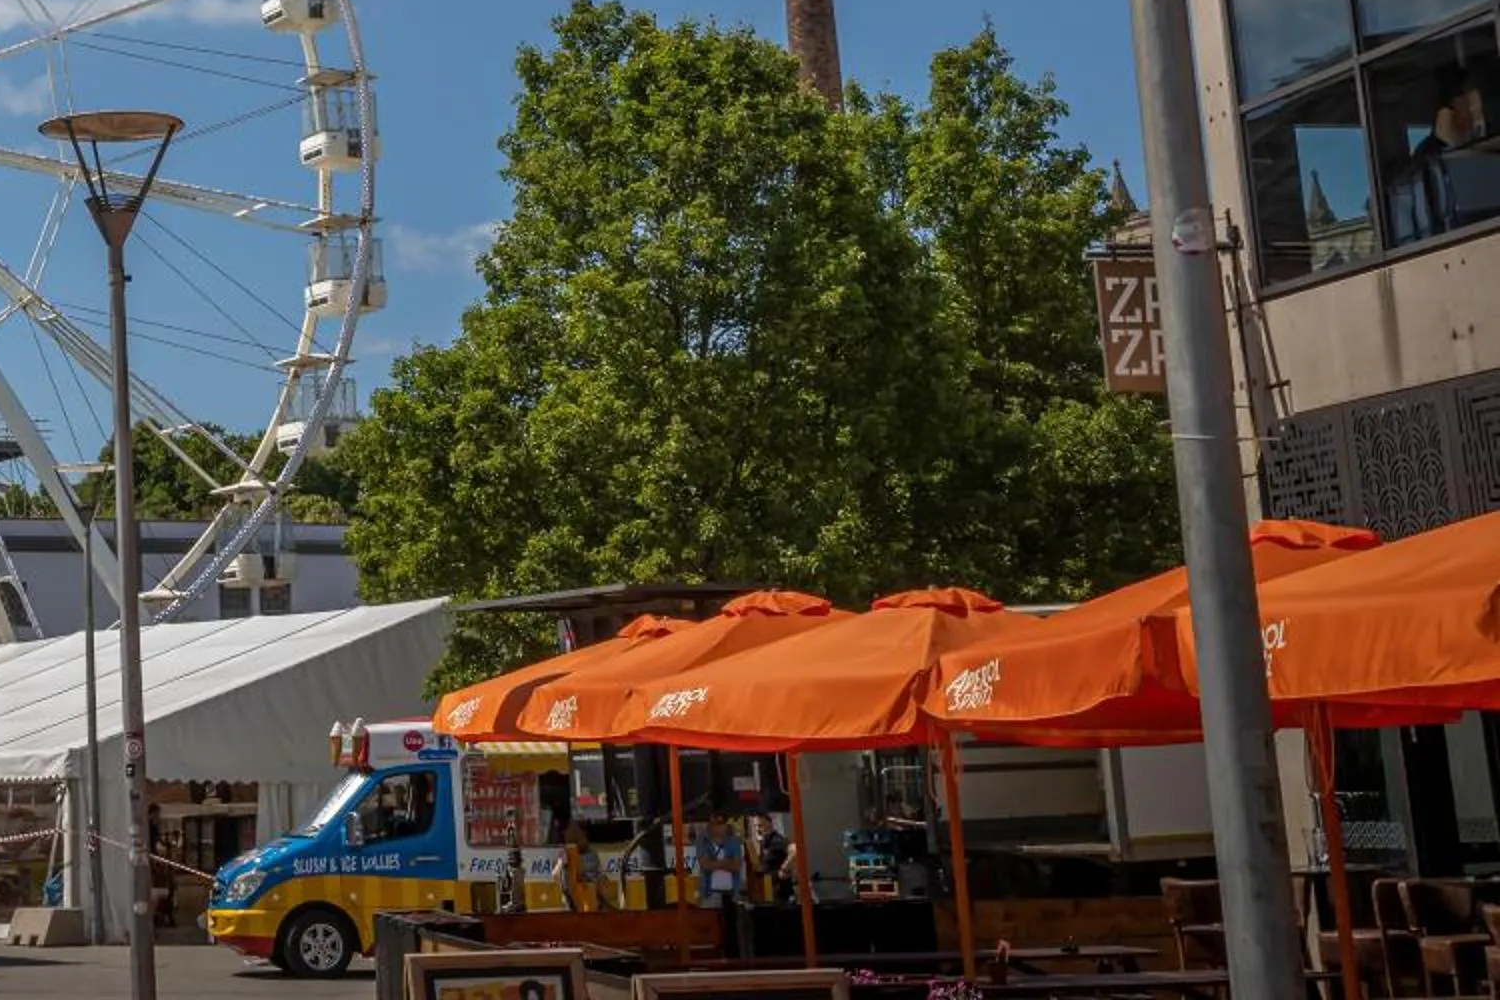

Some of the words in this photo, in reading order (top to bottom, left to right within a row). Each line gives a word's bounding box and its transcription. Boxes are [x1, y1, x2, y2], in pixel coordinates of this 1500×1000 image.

[945, 657, 1001, 696] APEROL
[293, 856, 328, 875] SLUSH
[361, 853, 400, 871] LOLLIES
